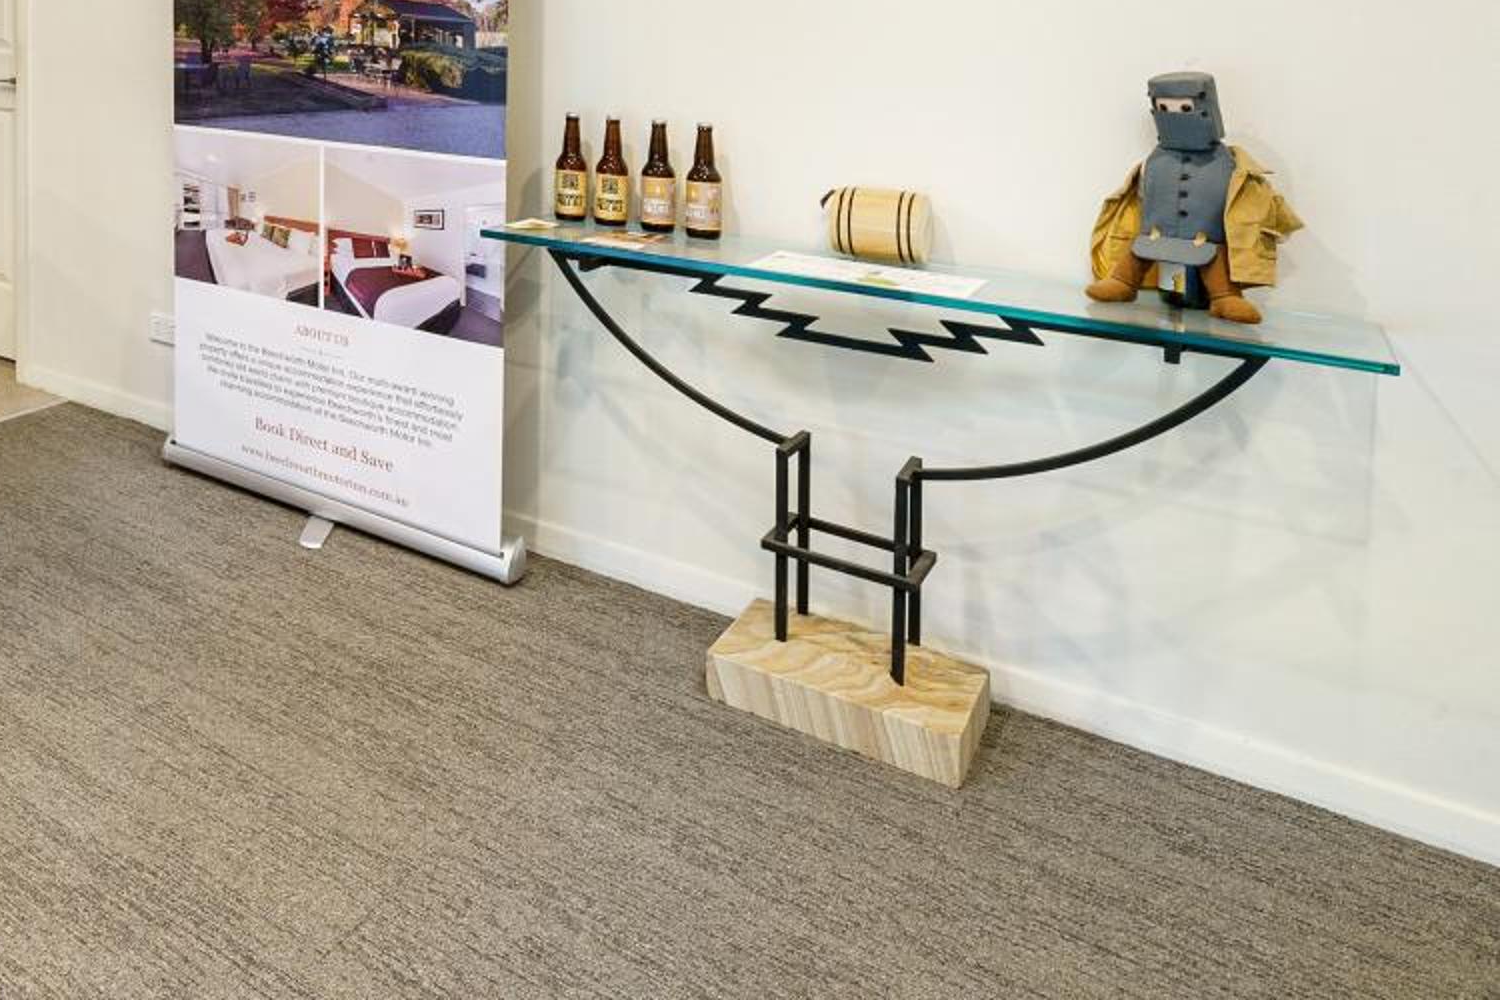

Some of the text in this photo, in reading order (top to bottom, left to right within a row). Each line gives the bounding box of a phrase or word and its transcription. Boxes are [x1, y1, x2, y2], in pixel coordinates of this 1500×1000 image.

[295, 324, 332, 343] ABOUT
[255, 416, 395, 473] Book Direct and Save
